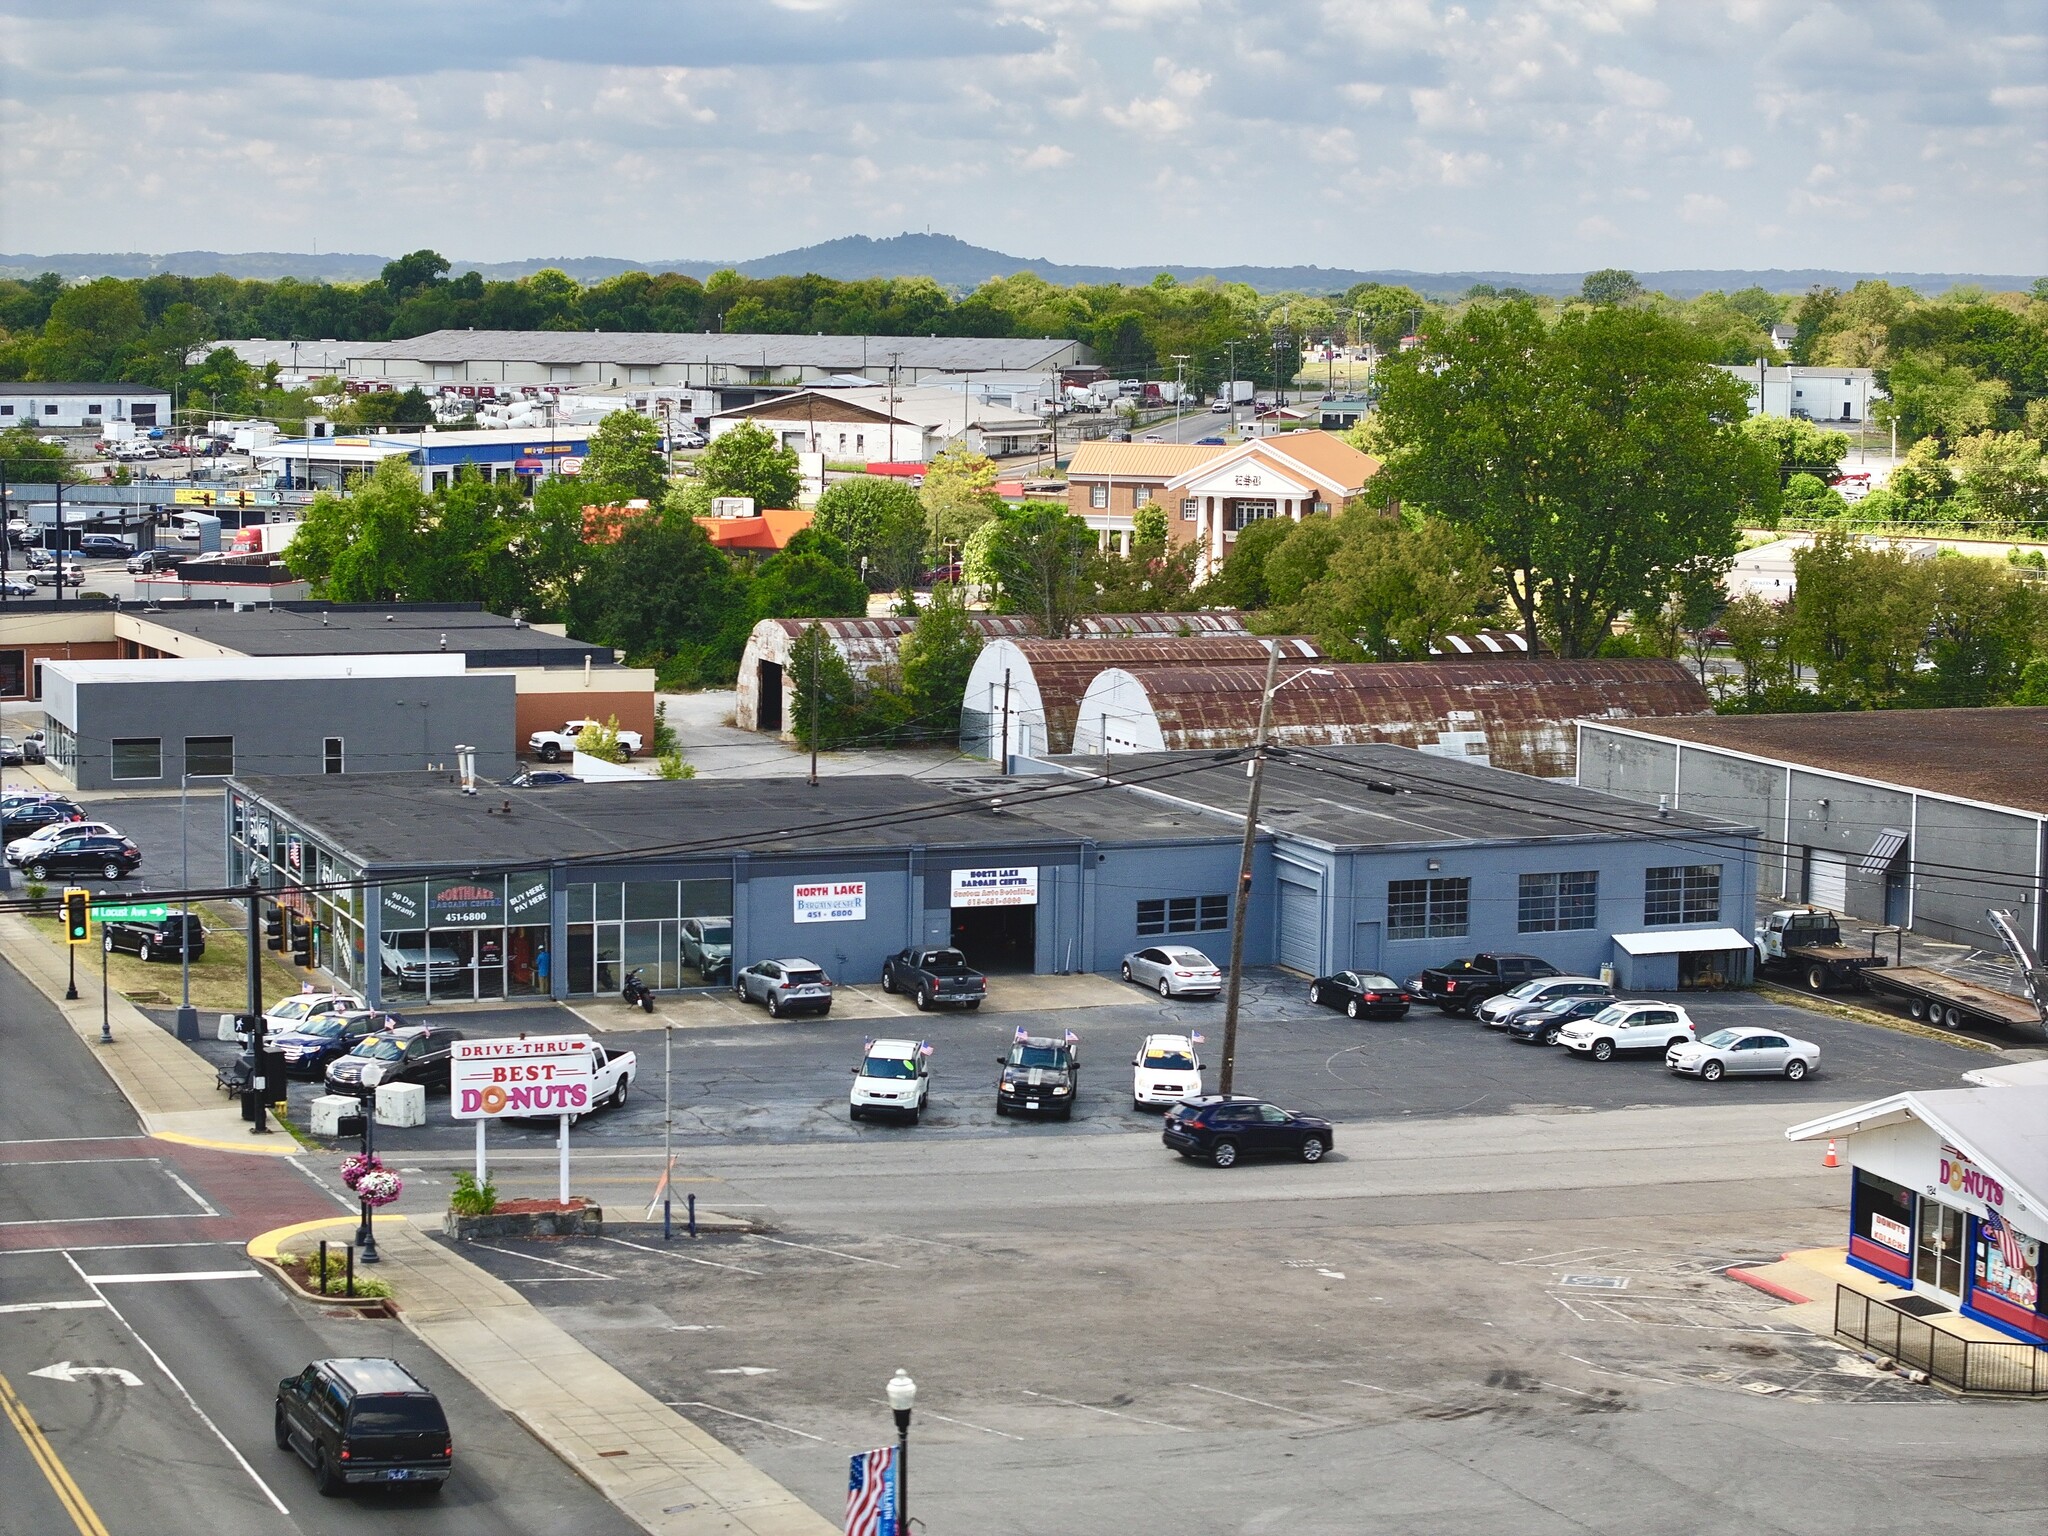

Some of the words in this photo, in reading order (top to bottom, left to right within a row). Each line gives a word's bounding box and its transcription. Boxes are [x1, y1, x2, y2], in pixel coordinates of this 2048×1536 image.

[970, 870, 997, 878] NORTH
[1000, 869, 1018, 877] LAKE
[961, 879, 997, 887] BARGAIN
[437, 886, 495, 900] NORTHLAKE
[509, 896, 526, 906] BUY
[526, 883, 545, 898] HERE
[796, 887, 829, 897] NORTH
[833, 885, 863, 895] LAKE
[391, 891, 401, 901] 90
[401, 896, 417, 908] Day
[431, 900, 468, 909] BARGAIN
[470, 898, 502, 907] CENTER
[514, 903, 529, 914] PAY
[529, 892, 548, 905] HERE
[798, 900, 832, 909] BARGAIN
[833, 897, 861, 907] CENTER
[92, 908, 99, 916] N
[101, 907, 128, 916] Locust
[130, 907, 147, 916] Ave
[384, 898, 417, 919] Warranty
[445, 912, 487, 922] 451-6800
[461, 1042, 568, 1056] DRIVE-THRU
[492, 1065, 556, 1082] BEST
[461, 1084, 587, 1114] DONUTS
[1939, 1159, 2004, 1206] DONUTS
[1926, 1185, 1937, 1196] 184
[1876, 1215, 1906, 1235] DONUTS
[1874, 1232, 1907, 1253] KOLACHE
[884, 1482, 893, 1520] GALLATIN
